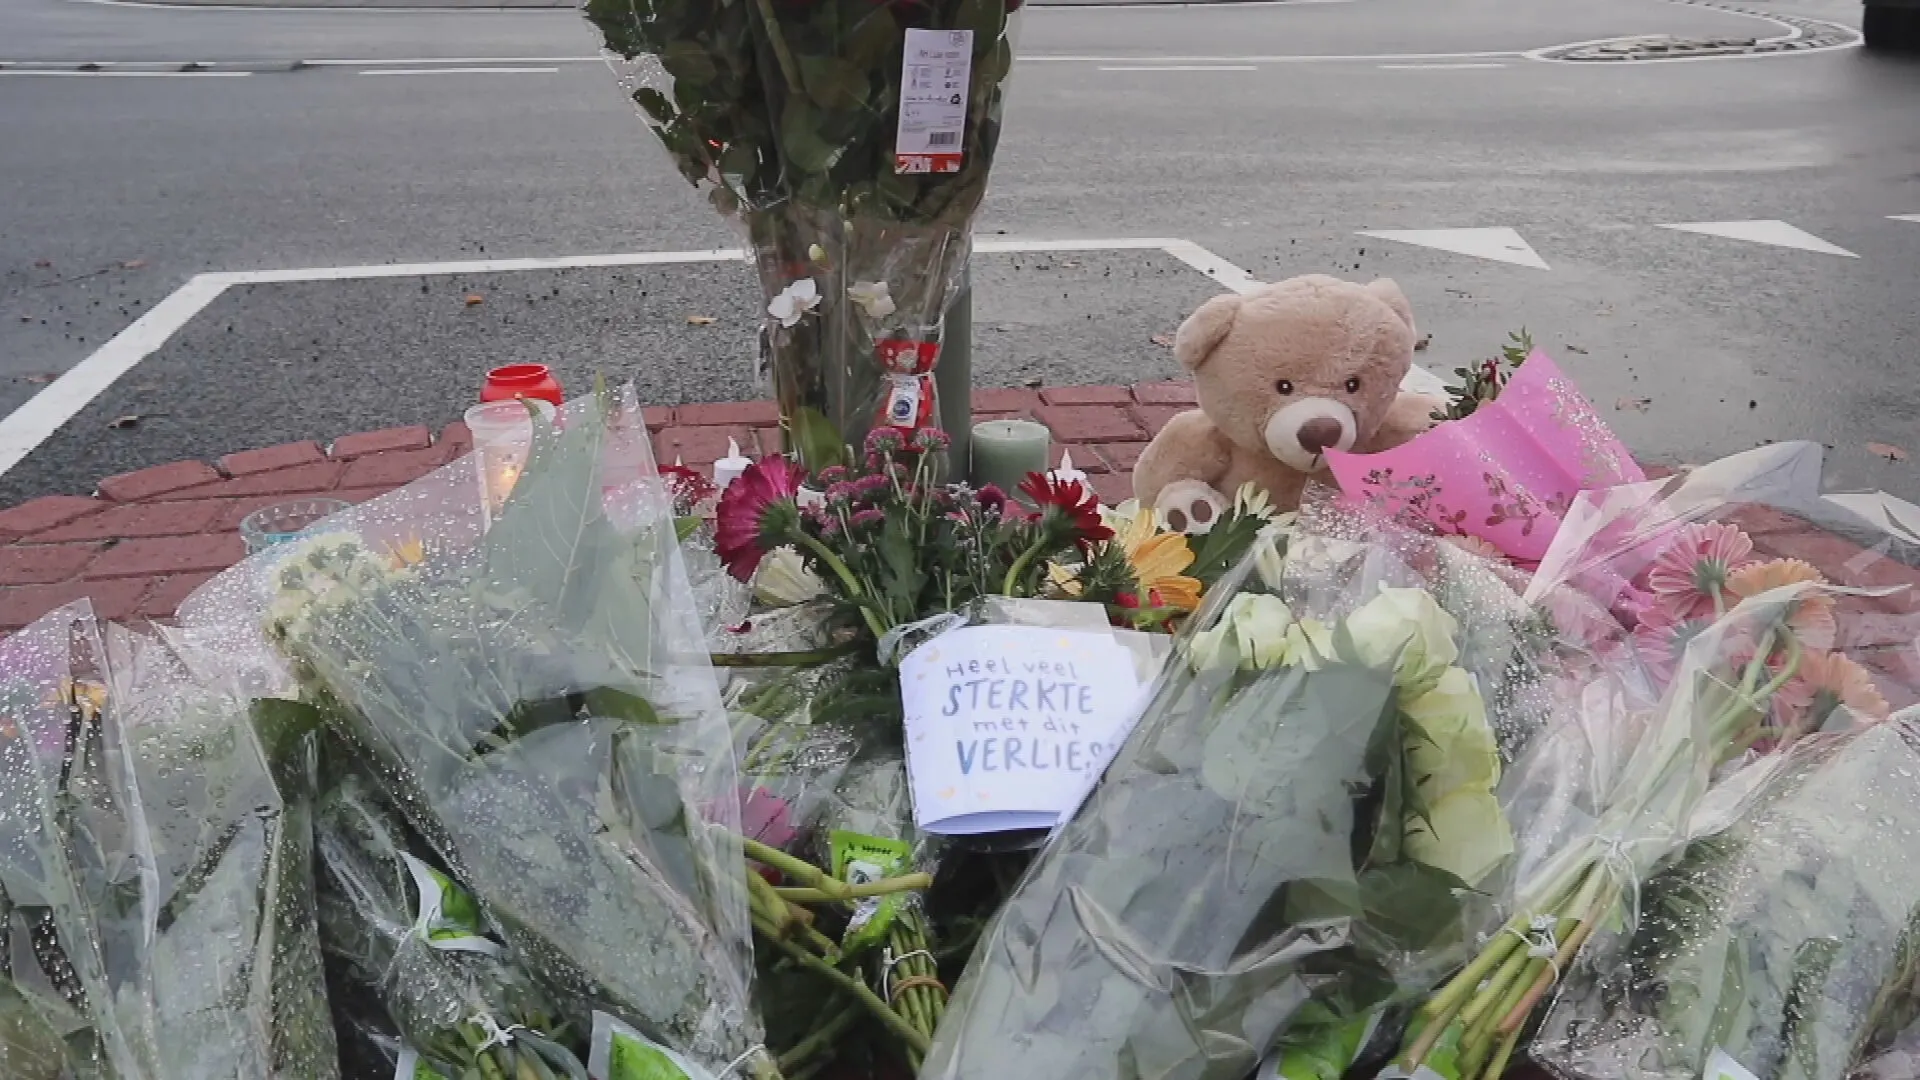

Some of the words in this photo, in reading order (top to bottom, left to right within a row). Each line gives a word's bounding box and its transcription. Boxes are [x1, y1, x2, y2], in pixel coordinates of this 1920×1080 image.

[946, 656, 1011, 678] Heel
[1022, 661, 1077, 679] veel
[942, 678, 1094, 717] STERKTE
[973, 717, 1029, 732] met
[1042, 716, 1080, 735] dit
